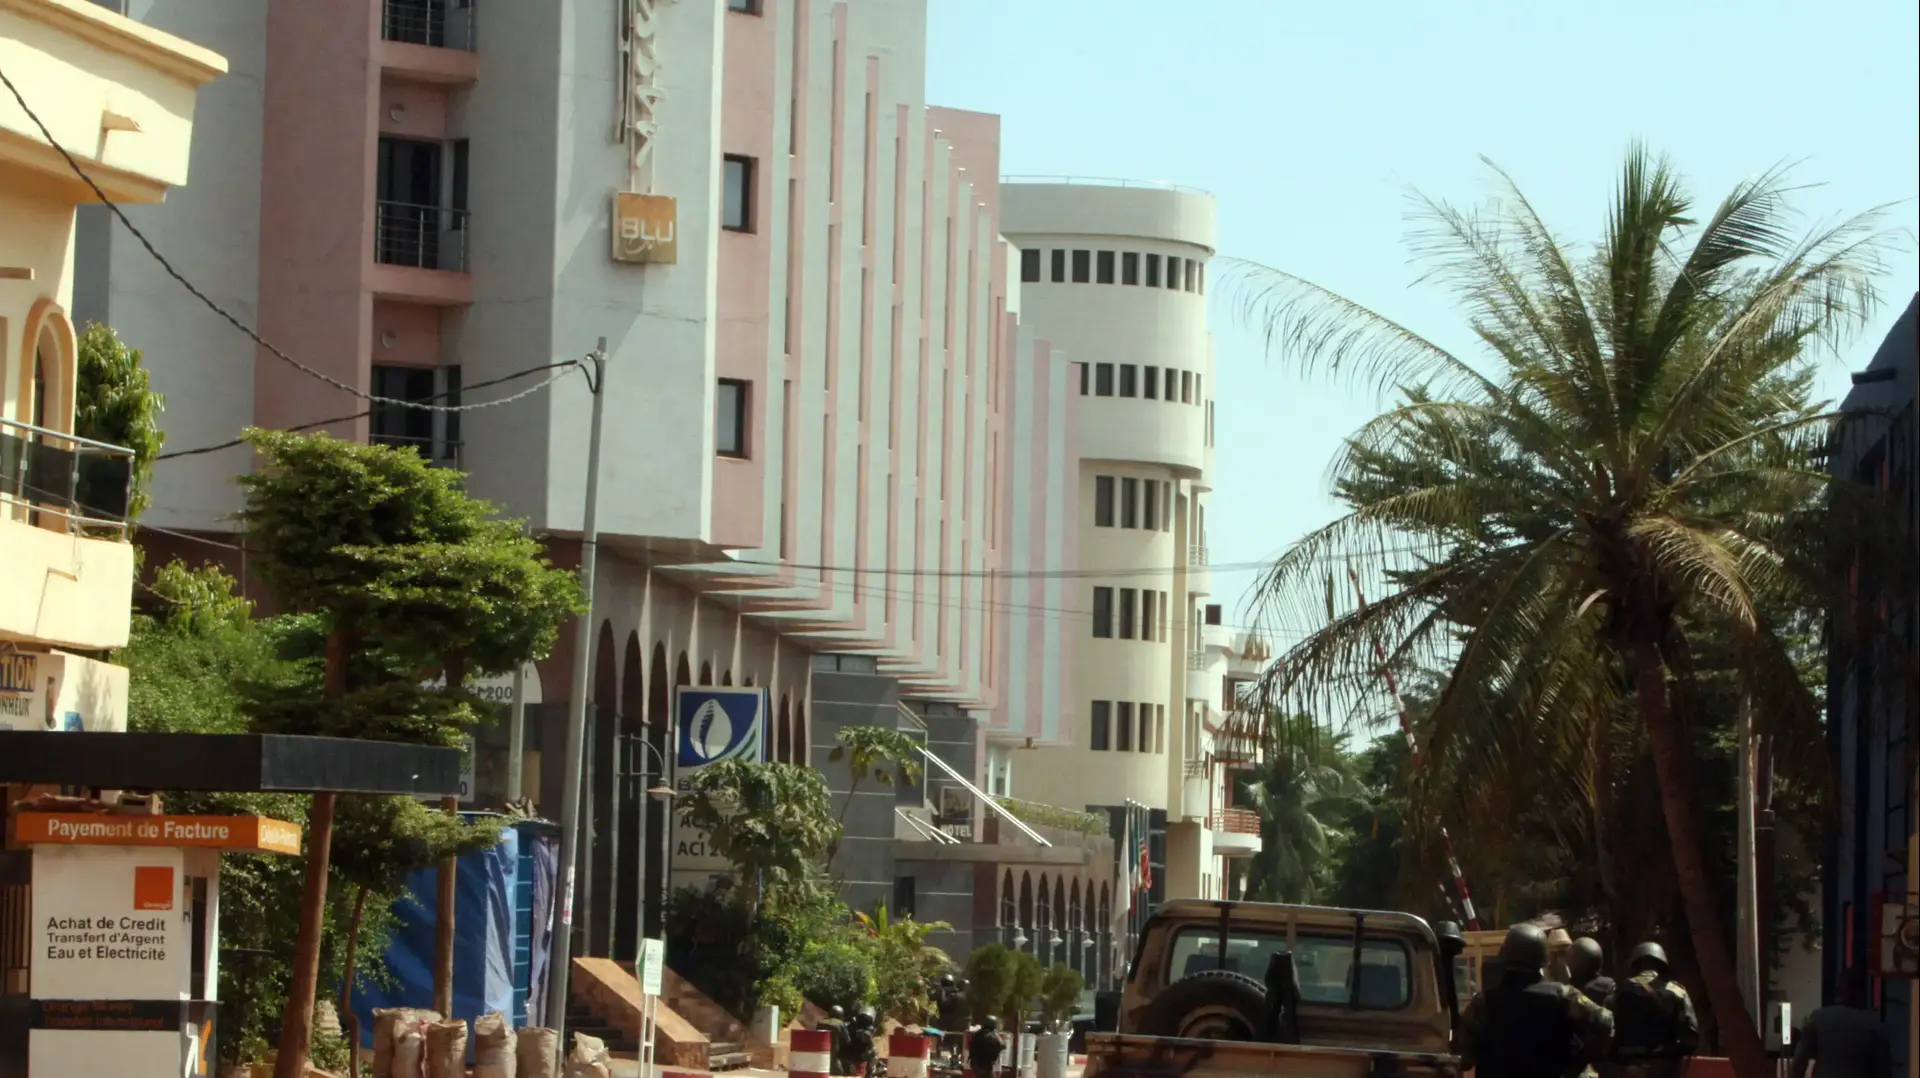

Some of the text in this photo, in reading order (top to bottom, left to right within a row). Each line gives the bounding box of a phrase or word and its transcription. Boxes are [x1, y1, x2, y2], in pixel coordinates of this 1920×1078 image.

[621, 217, 674, 243] BLU
[0, 696, 30, 717] NHEUR
[48, 819, 230, 840] Payement de Facture
[940, 823, 972, 837] HOTEL
[677, 840, 705, 856] ACI
[47, 916, 166, 931] Achat de Credit
[47, 932, 165, 946] Transfert d'Argent
[47, 946, 75, 959] Eau
[78, 947, 92, 959] et
